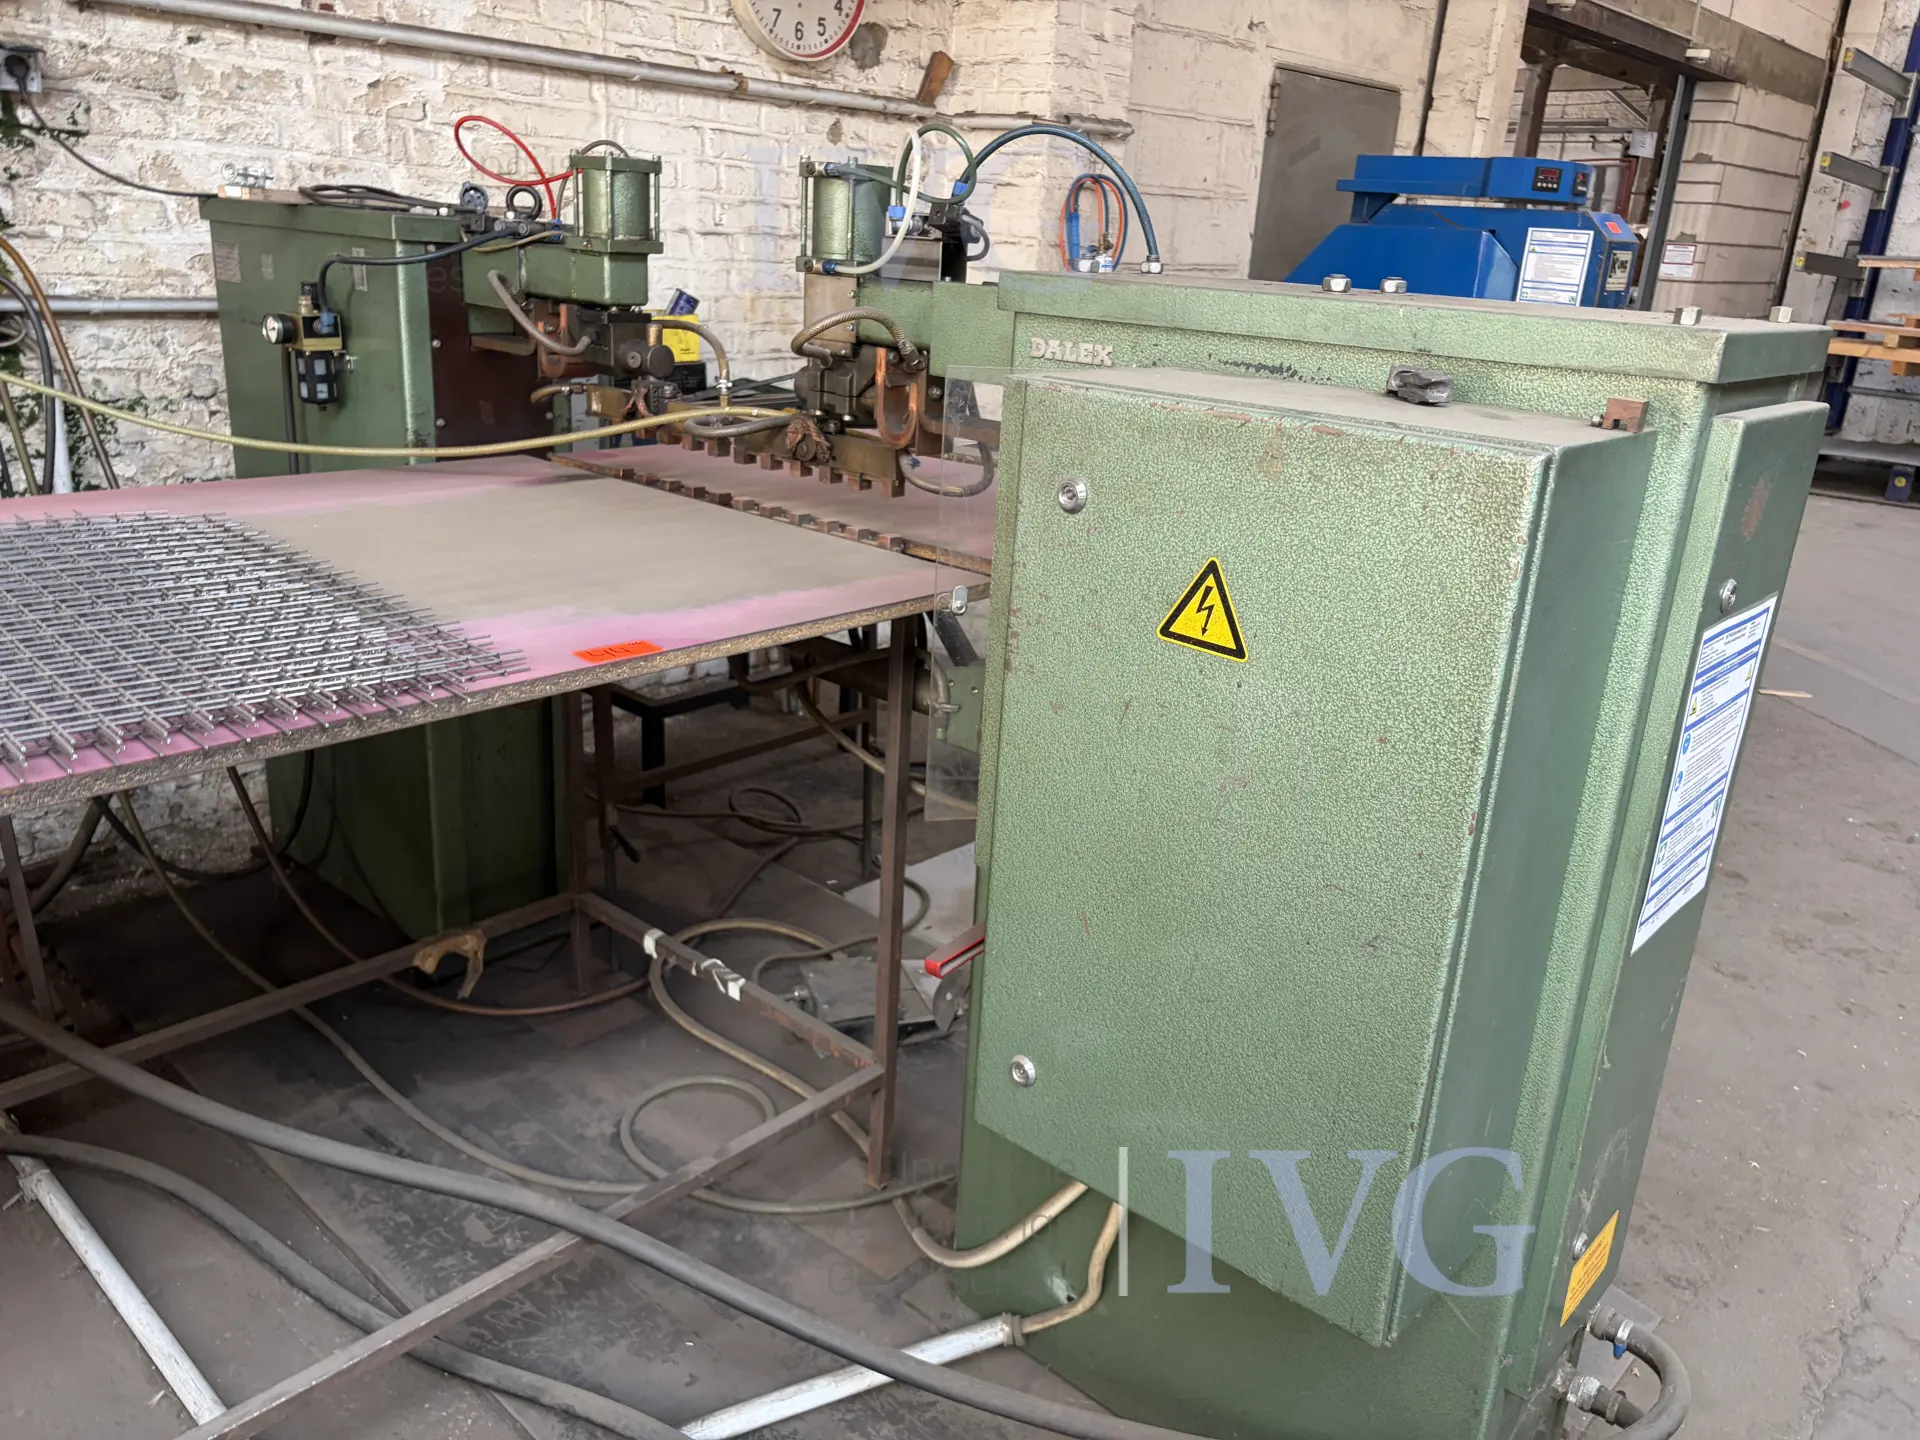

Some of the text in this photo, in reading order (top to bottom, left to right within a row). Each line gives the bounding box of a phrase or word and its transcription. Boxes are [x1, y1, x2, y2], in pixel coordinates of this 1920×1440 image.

[772, 8, 781, 28] 7
[817, 17, 826, 36] 5
[795, 21, 804, 41] 6
[1030, 337, 1113, 367] DALEX
